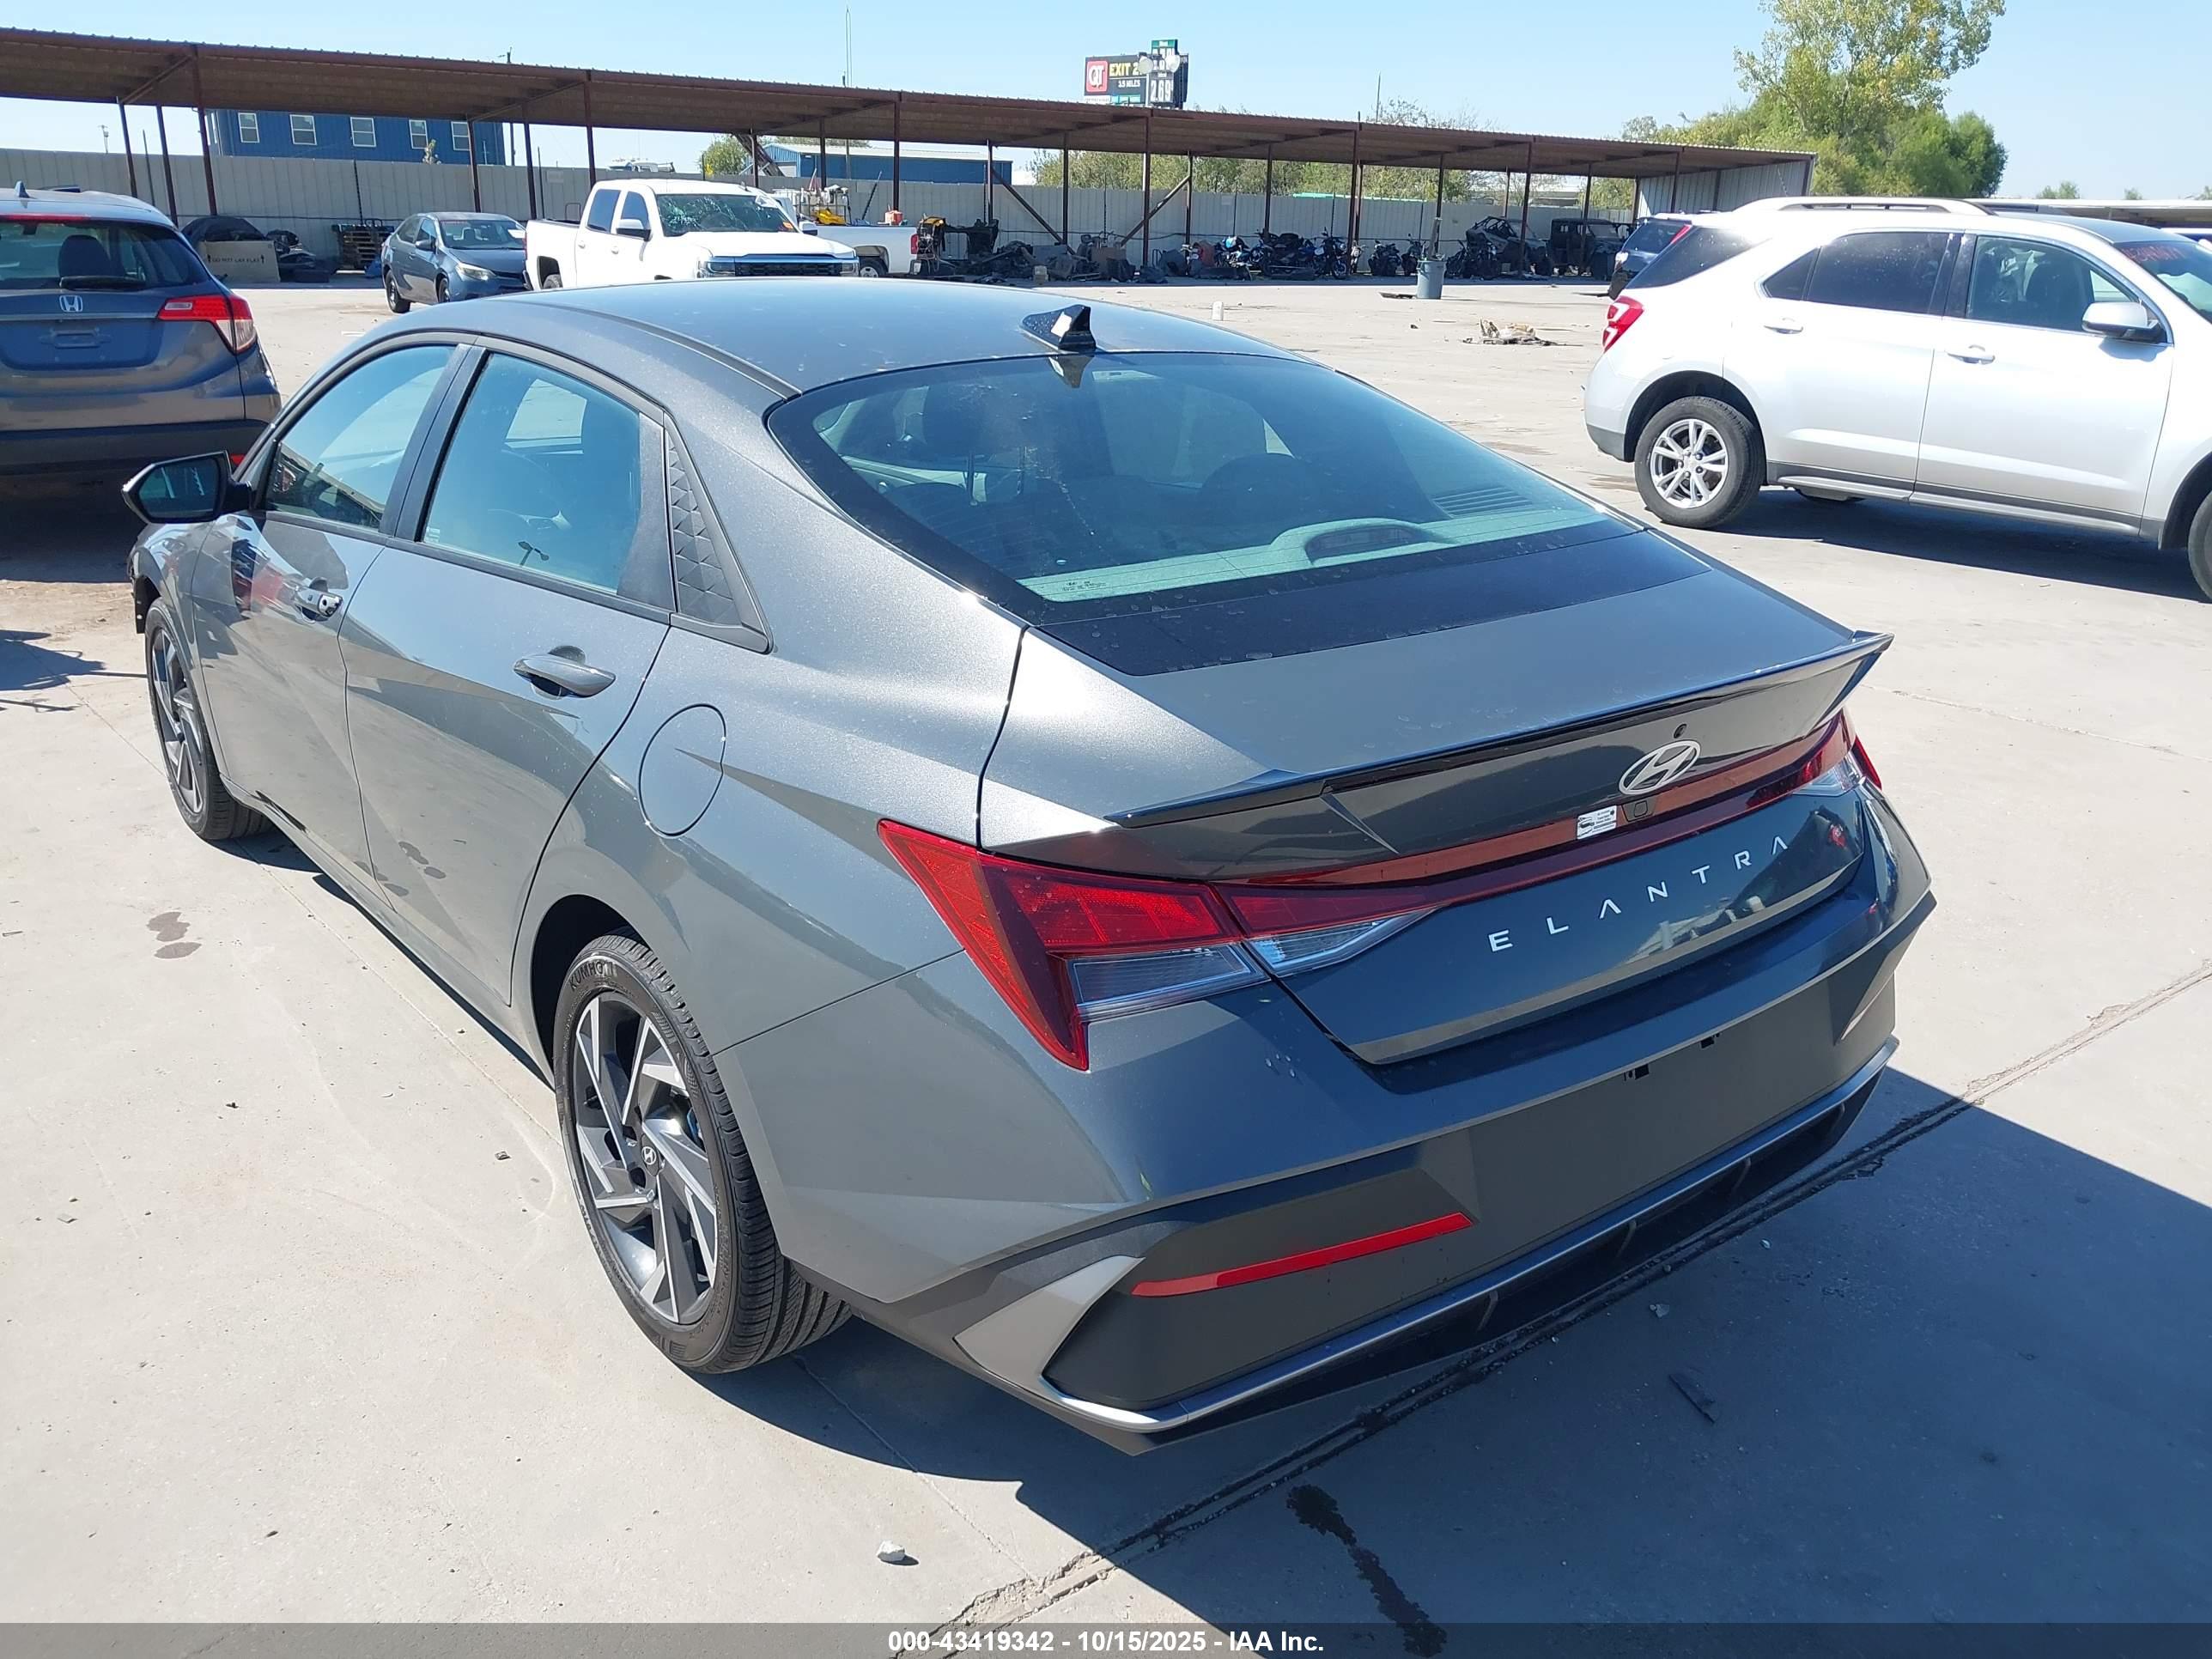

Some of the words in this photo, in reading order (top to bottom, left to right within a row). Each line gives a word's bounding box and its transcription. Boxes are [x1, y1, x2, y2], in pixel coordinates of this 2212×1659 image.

[1089, 65, 1104, 87] QT
[1109, 63, 1131, 76] EXIT
[1488, 836, 1789, 952] ELANTRA
